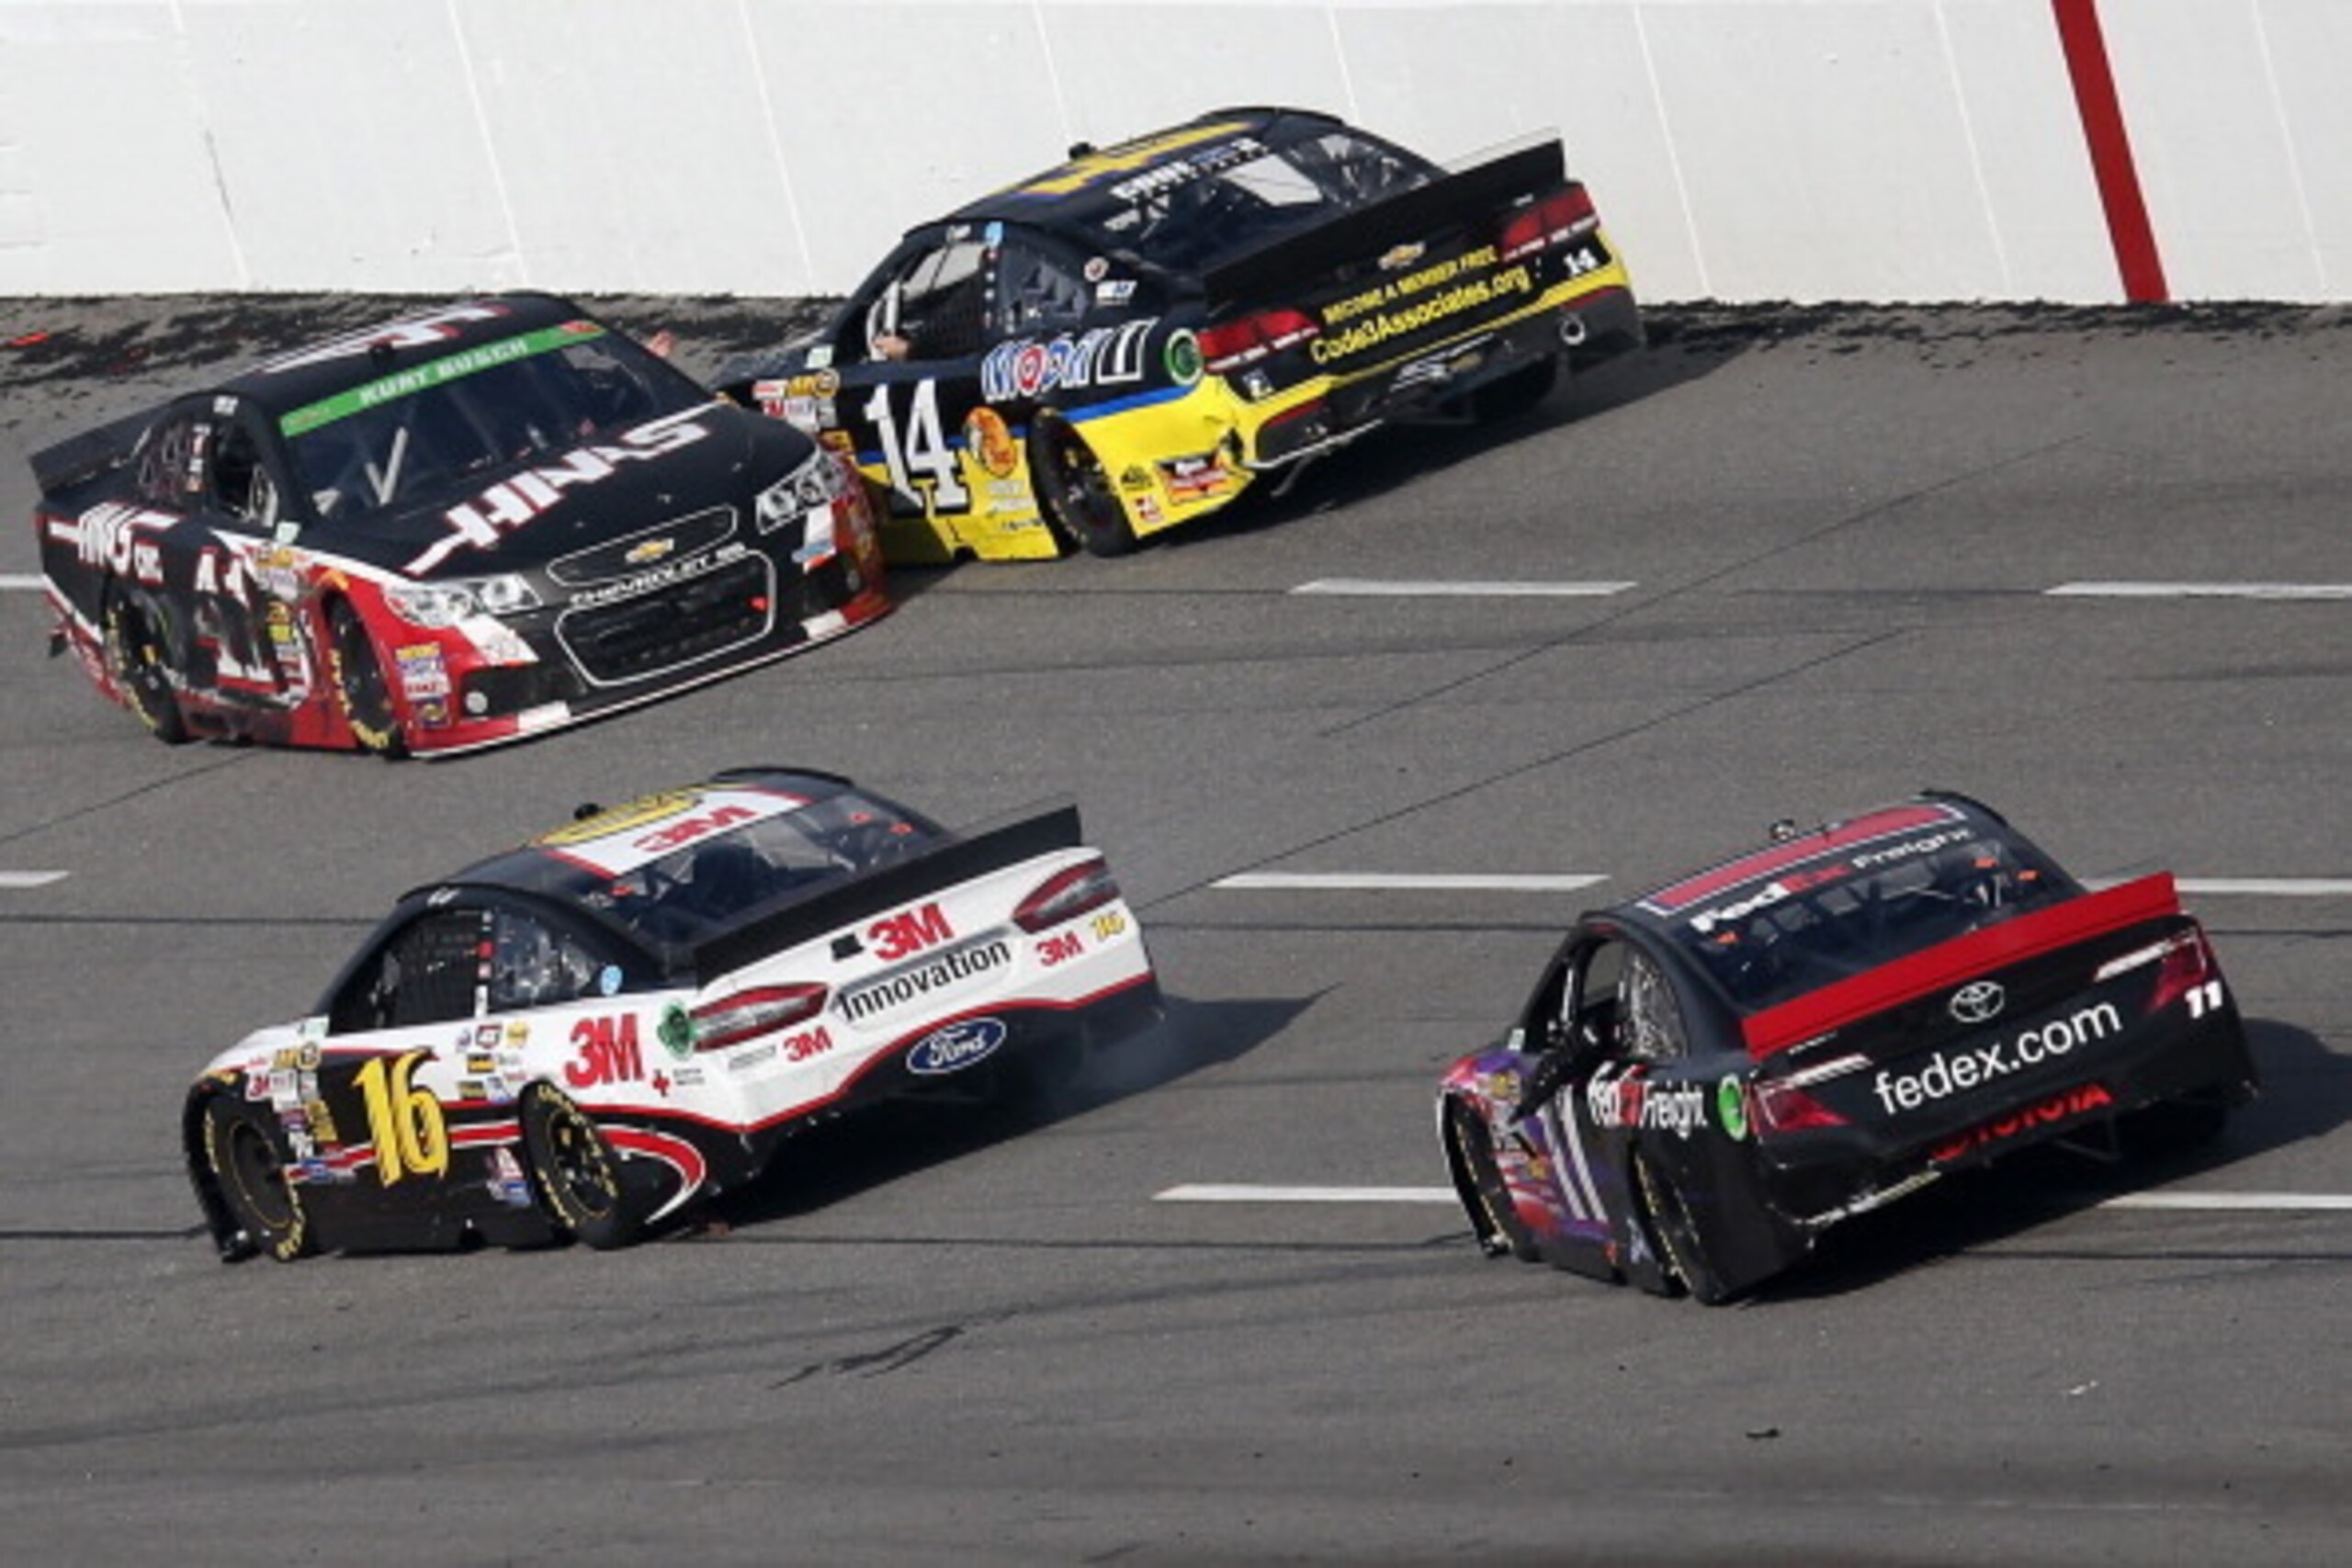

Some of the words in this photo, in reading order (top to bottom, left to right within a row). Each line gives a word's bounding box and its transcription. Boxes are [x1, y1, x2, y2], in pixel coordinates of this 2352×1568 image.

[1563, 247, 1599, 276] 14
[1310, 265, 1532, 364] Code3Associates.org
[863, 378, 970, 510] 14
[867, 902, 956, 962] 3M
[1035, 931, 1084, 967] 3M
[838, 939, 1012, 1024] Innovation
[2184, 980, 2223, 1021] 11
[564, 1012, 645, 1089] 3M
[783, 1025, 833, 1063] 3M
[926, 1024, 989, 1067] Ford
[1872, 1000, 2124, 1115] fedex.com
[351, 1046, 449, 1190] 16
